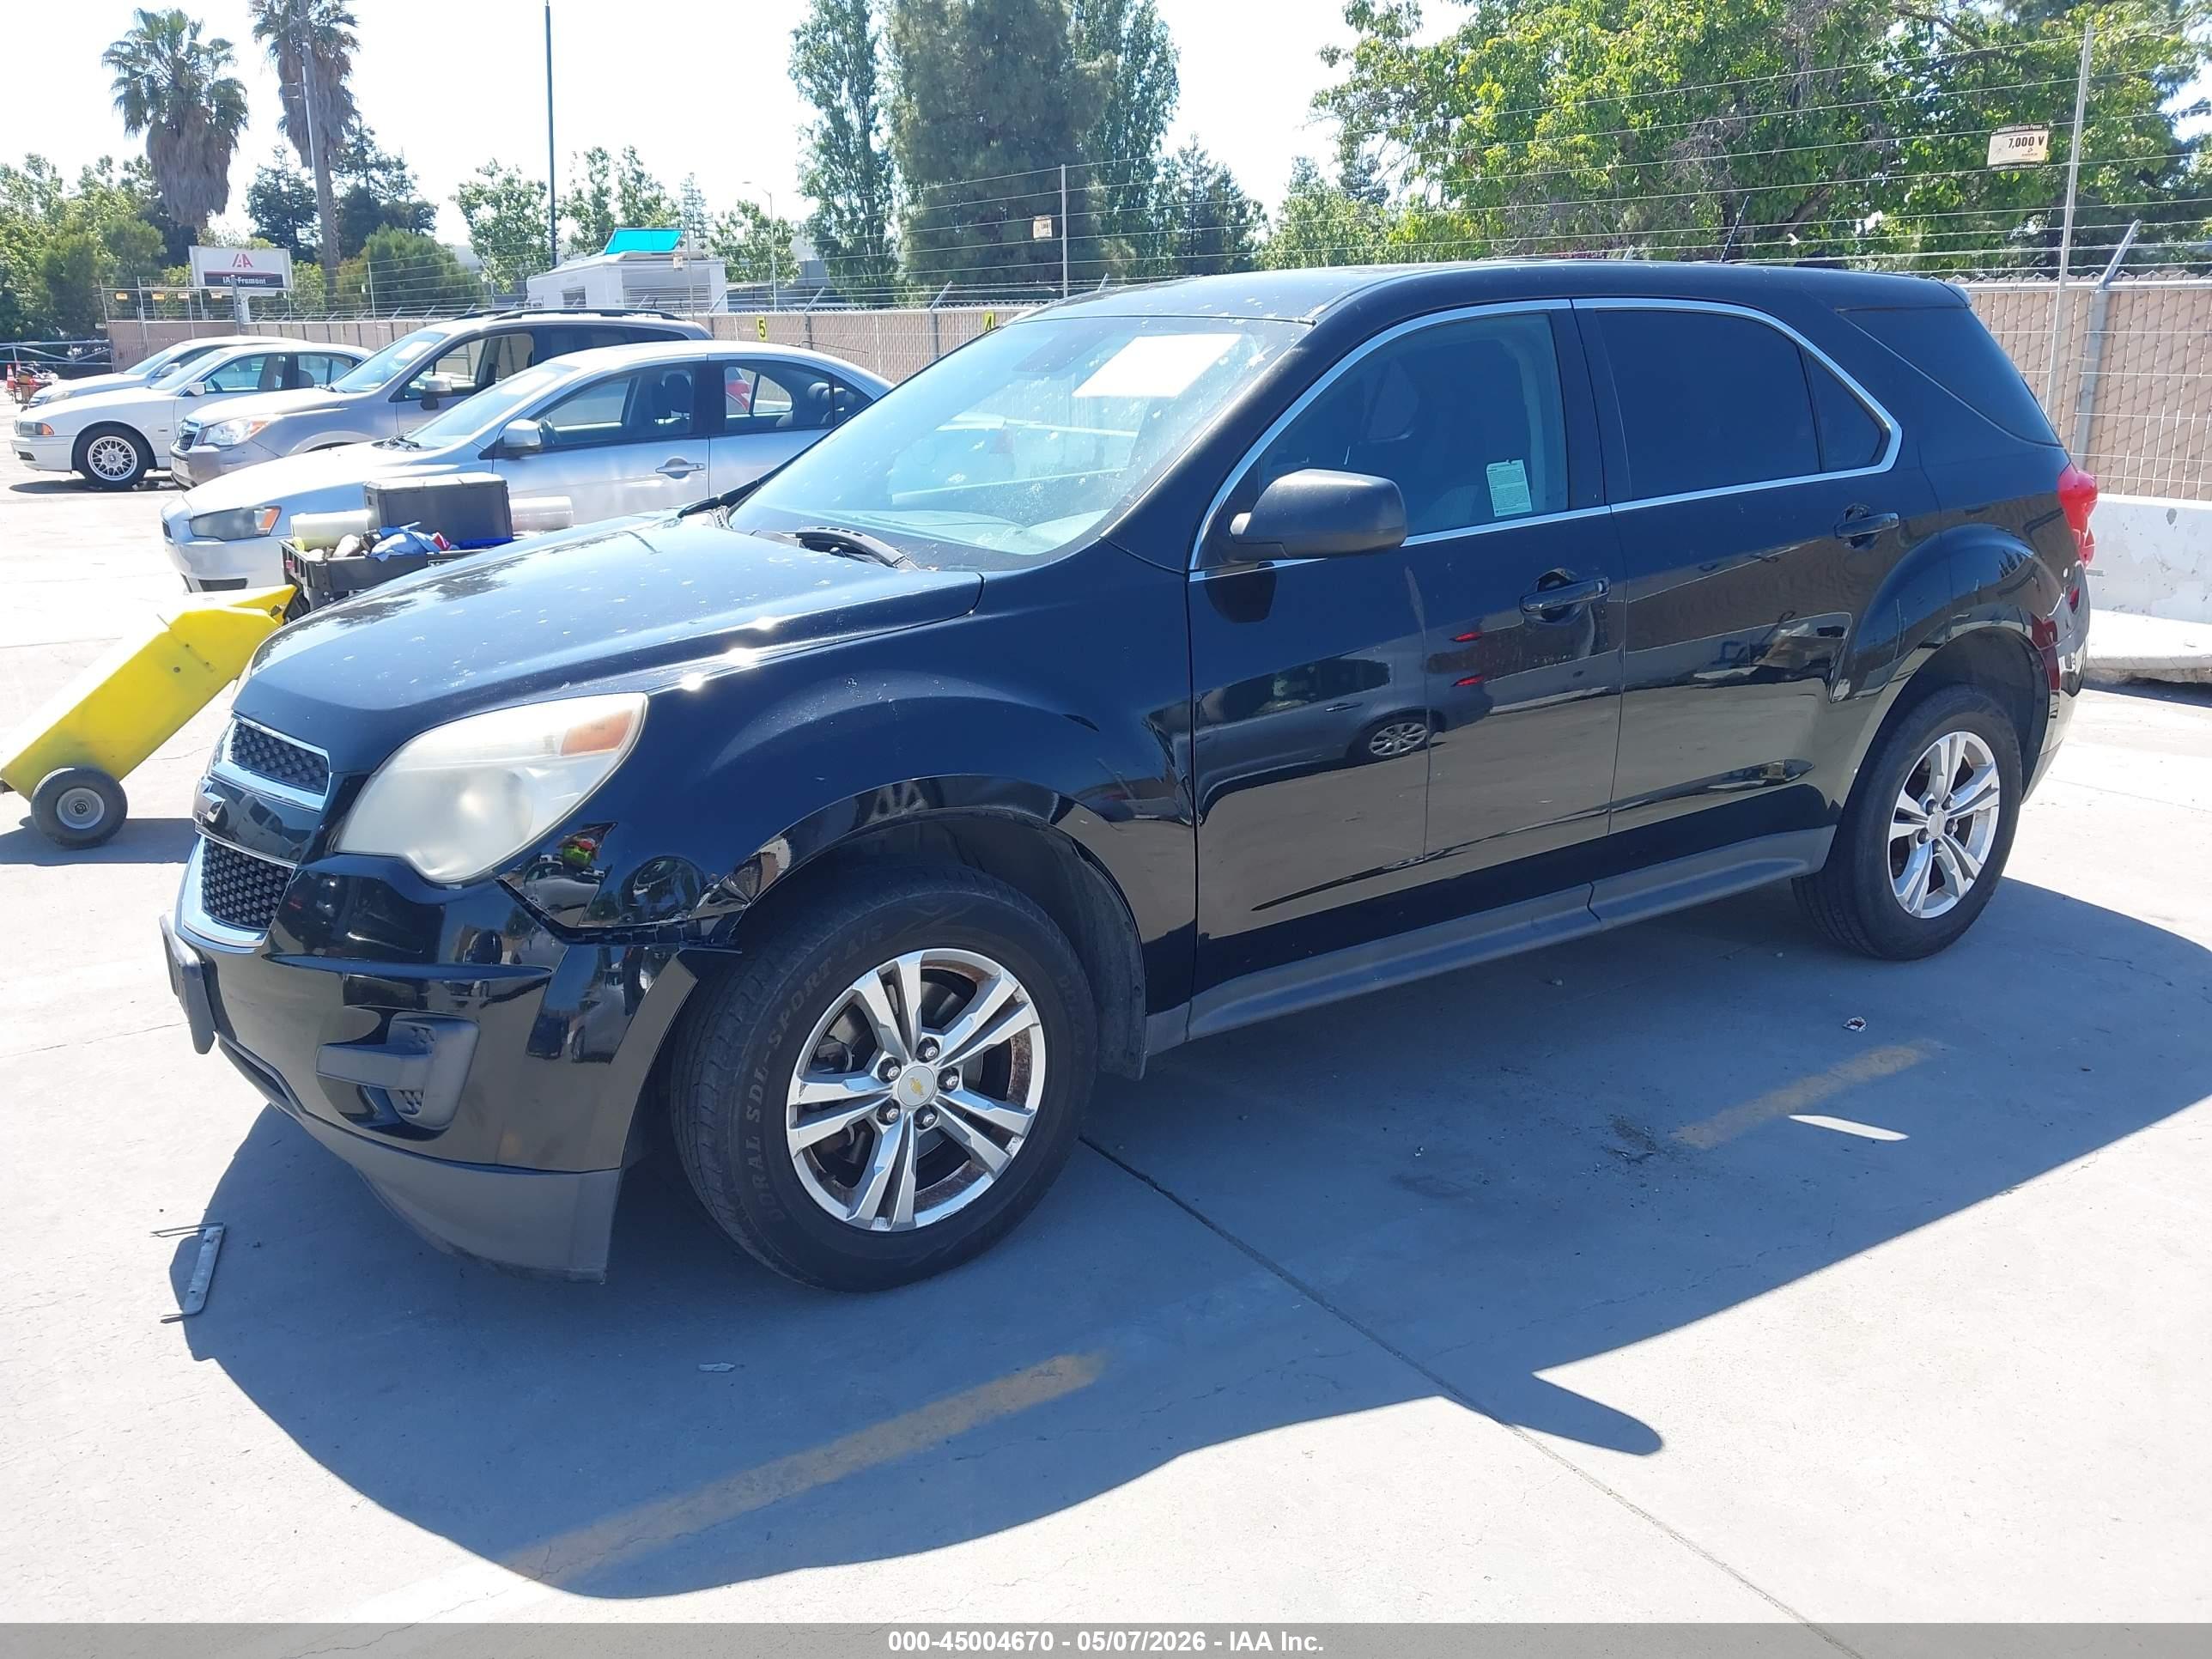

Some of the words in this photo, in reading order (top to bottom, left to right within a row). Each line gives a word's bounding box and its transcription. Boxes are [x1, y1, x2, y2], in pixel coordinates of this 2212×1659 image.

[2008, 136, 2034, 149] 7,000
[2038, 136, 2045, 146] V
[237, 276, 266, 285] Fremont
[758, 319, 766, 338] 5
